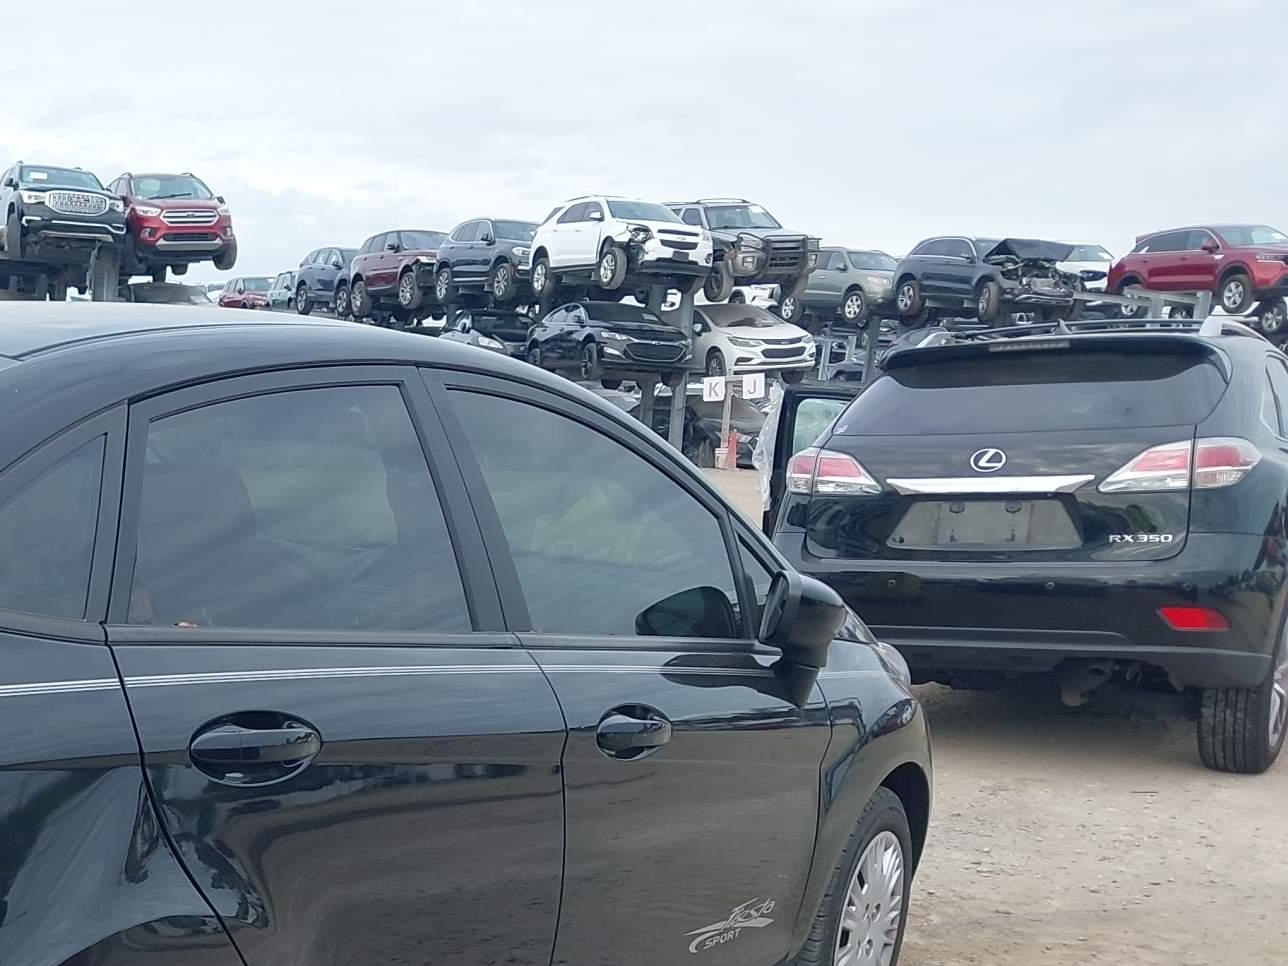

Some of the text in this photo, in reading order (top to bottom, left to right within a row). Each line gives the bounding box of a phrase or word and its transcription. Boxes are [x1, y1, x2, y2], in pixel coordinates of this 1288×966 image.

[708, 381, 720, 397] K
[747, 380, 757, 394] J
[703, 928, 741, 949] SPORT
